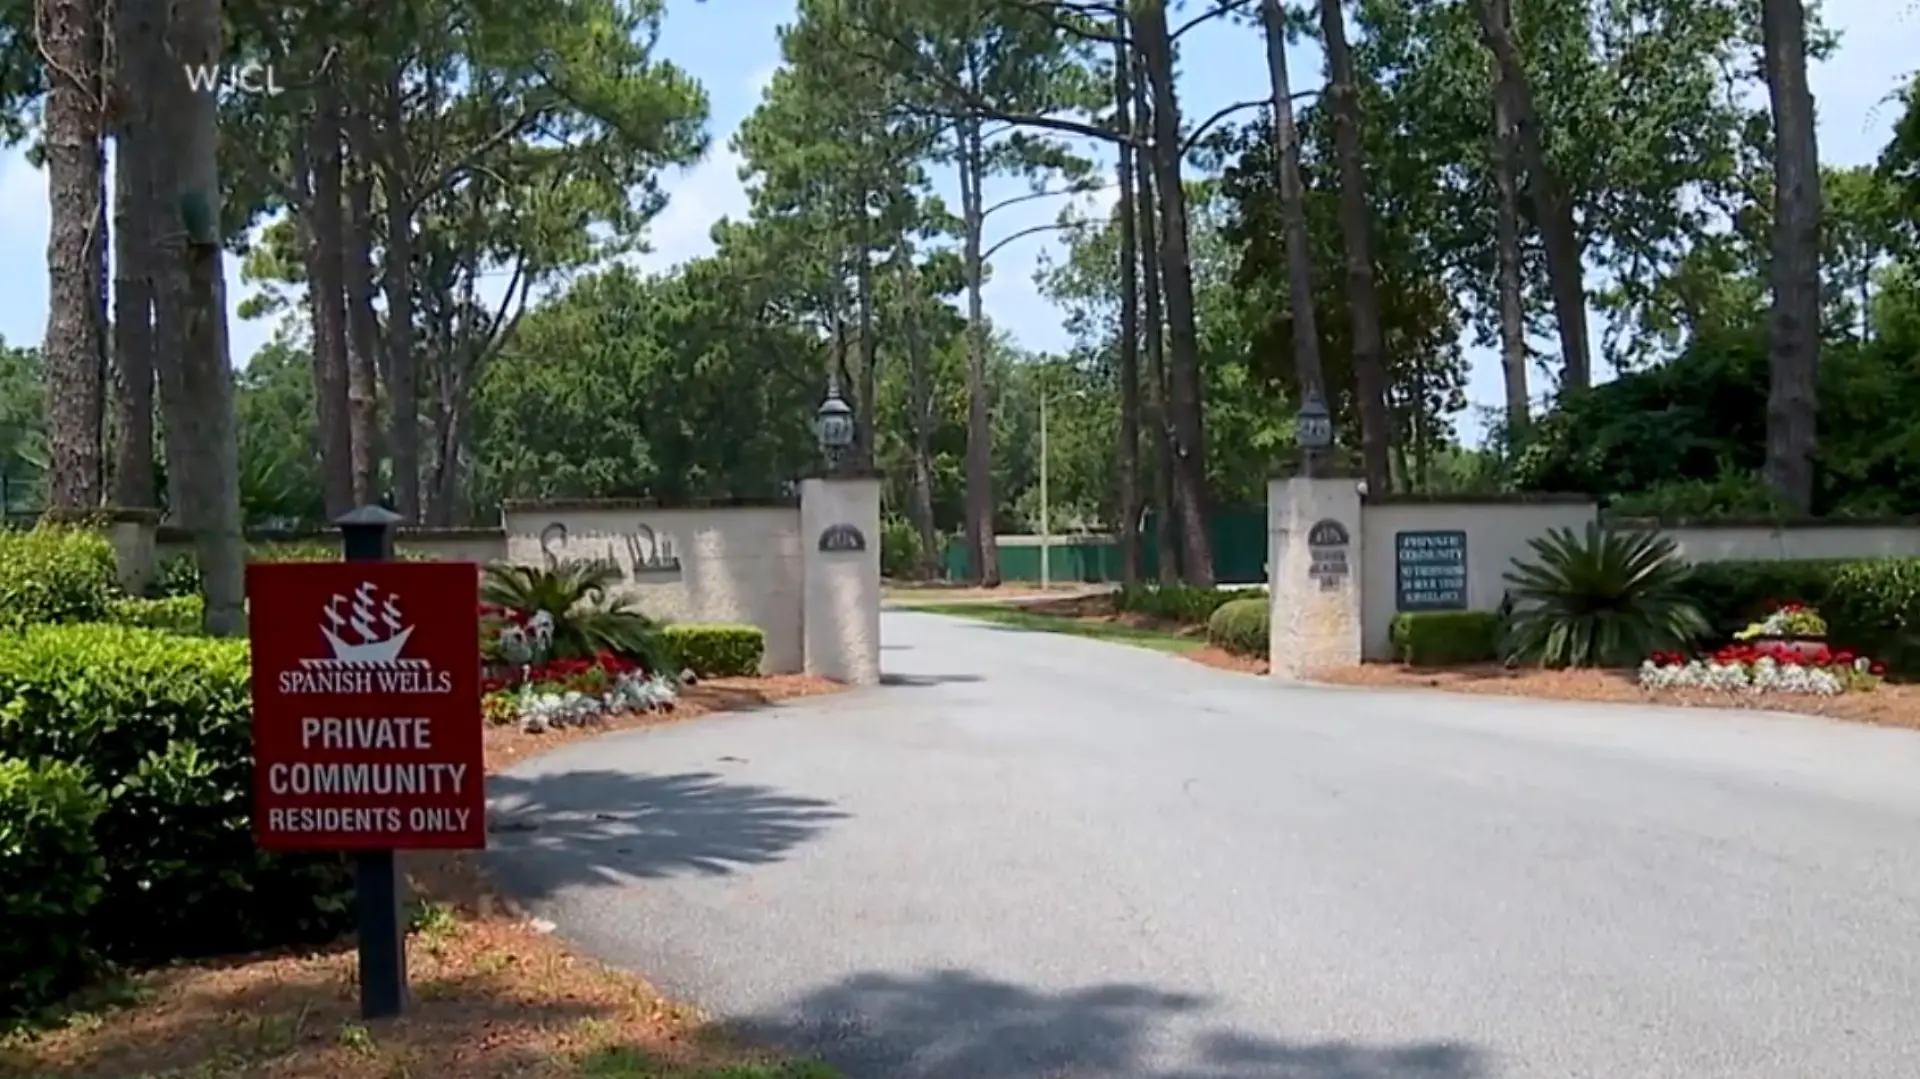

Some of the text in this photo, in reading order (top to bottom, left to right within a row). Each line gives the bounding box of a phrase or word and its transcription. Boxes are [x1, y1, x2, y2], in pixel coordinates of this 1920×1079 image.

[278, 671, 452, 694] SPANISH WELLS
[301, 716, 432, 749] PRIVATE
[268, 762, 467, 795] COMMUNITY
[268, 807, 470, 832] RESIDENTS ONLY
